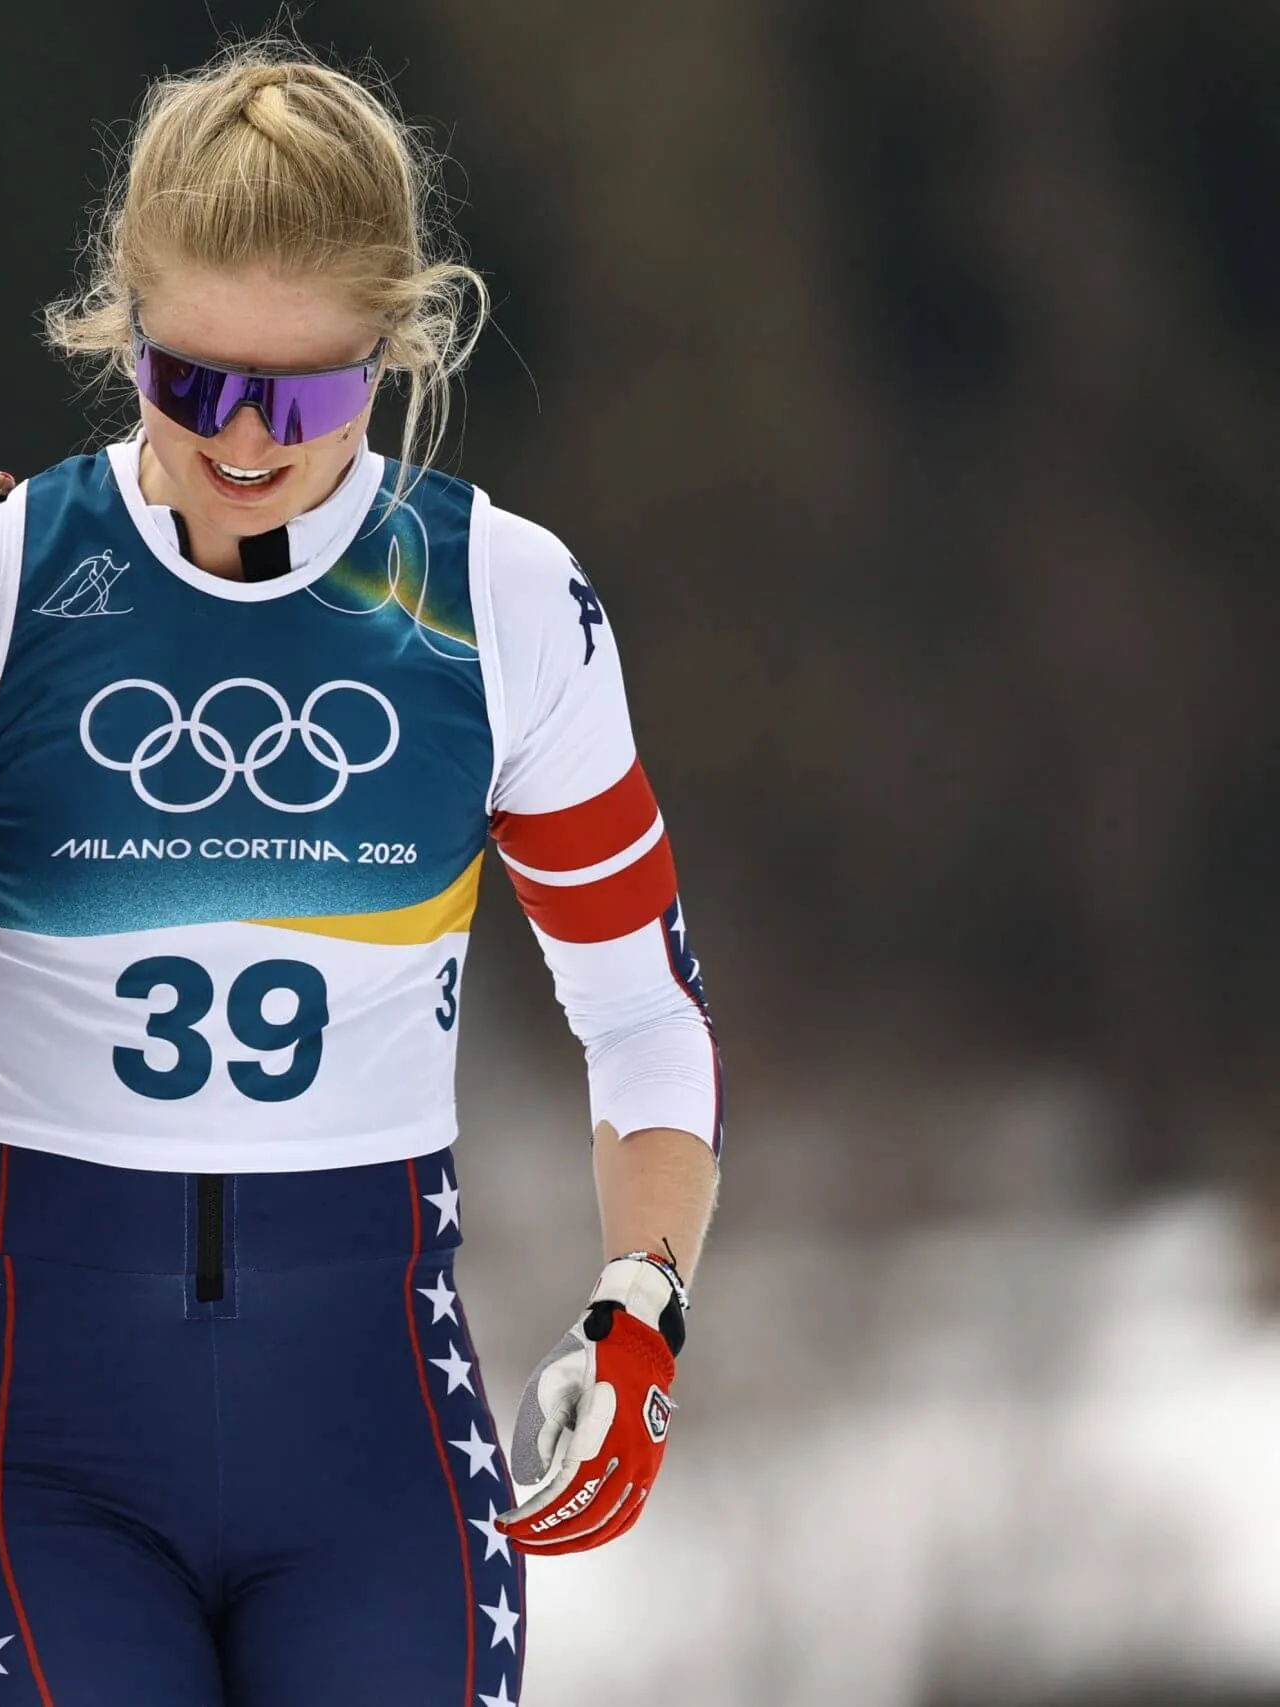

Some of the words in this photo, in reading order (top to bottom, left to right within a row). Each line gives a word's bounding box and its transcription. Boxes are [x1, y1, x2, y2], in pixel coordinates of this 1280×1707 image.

[50, 838, 192, 860] MILANO
[199, 838, 350, 862] CORTINA
[357, 842, 418, 864] 2026
[435, 956, 457, 1032] 3
[112, 955, 330, 1102] 39
[530, 1478, 600, 1533] HESTRA
